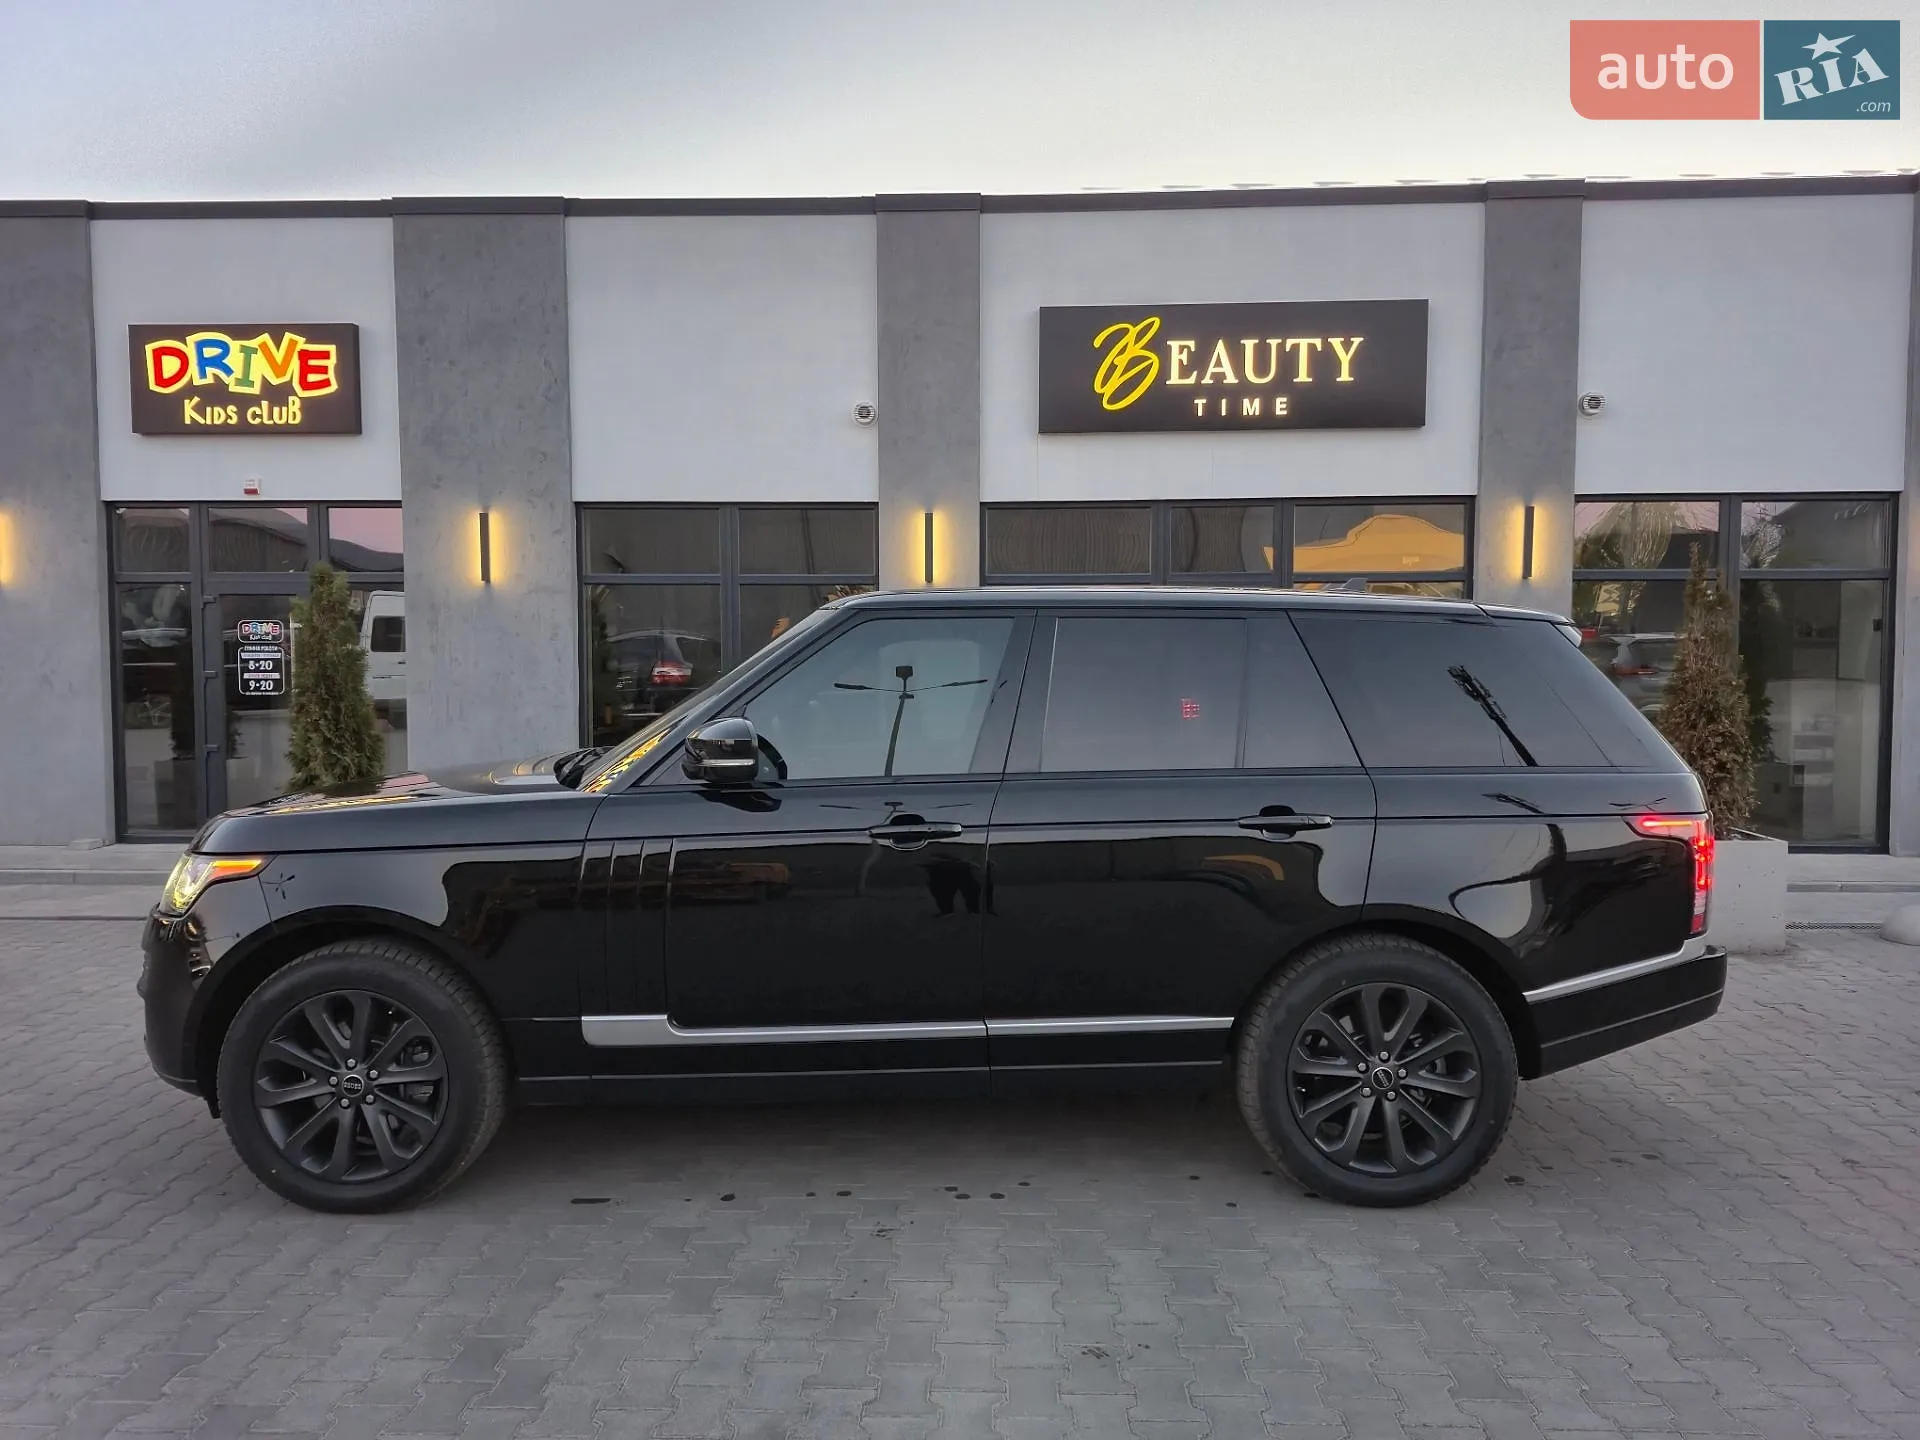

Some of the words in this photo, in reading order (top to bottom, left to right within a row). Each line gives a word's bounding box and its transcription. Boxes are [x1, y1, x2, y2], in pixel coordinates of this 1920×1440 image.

[145, 332, 339, 398] DRIVE
[1092, 316, 1364, 411] BEAUTY
[1194, 397, 1288, 416] TIME
